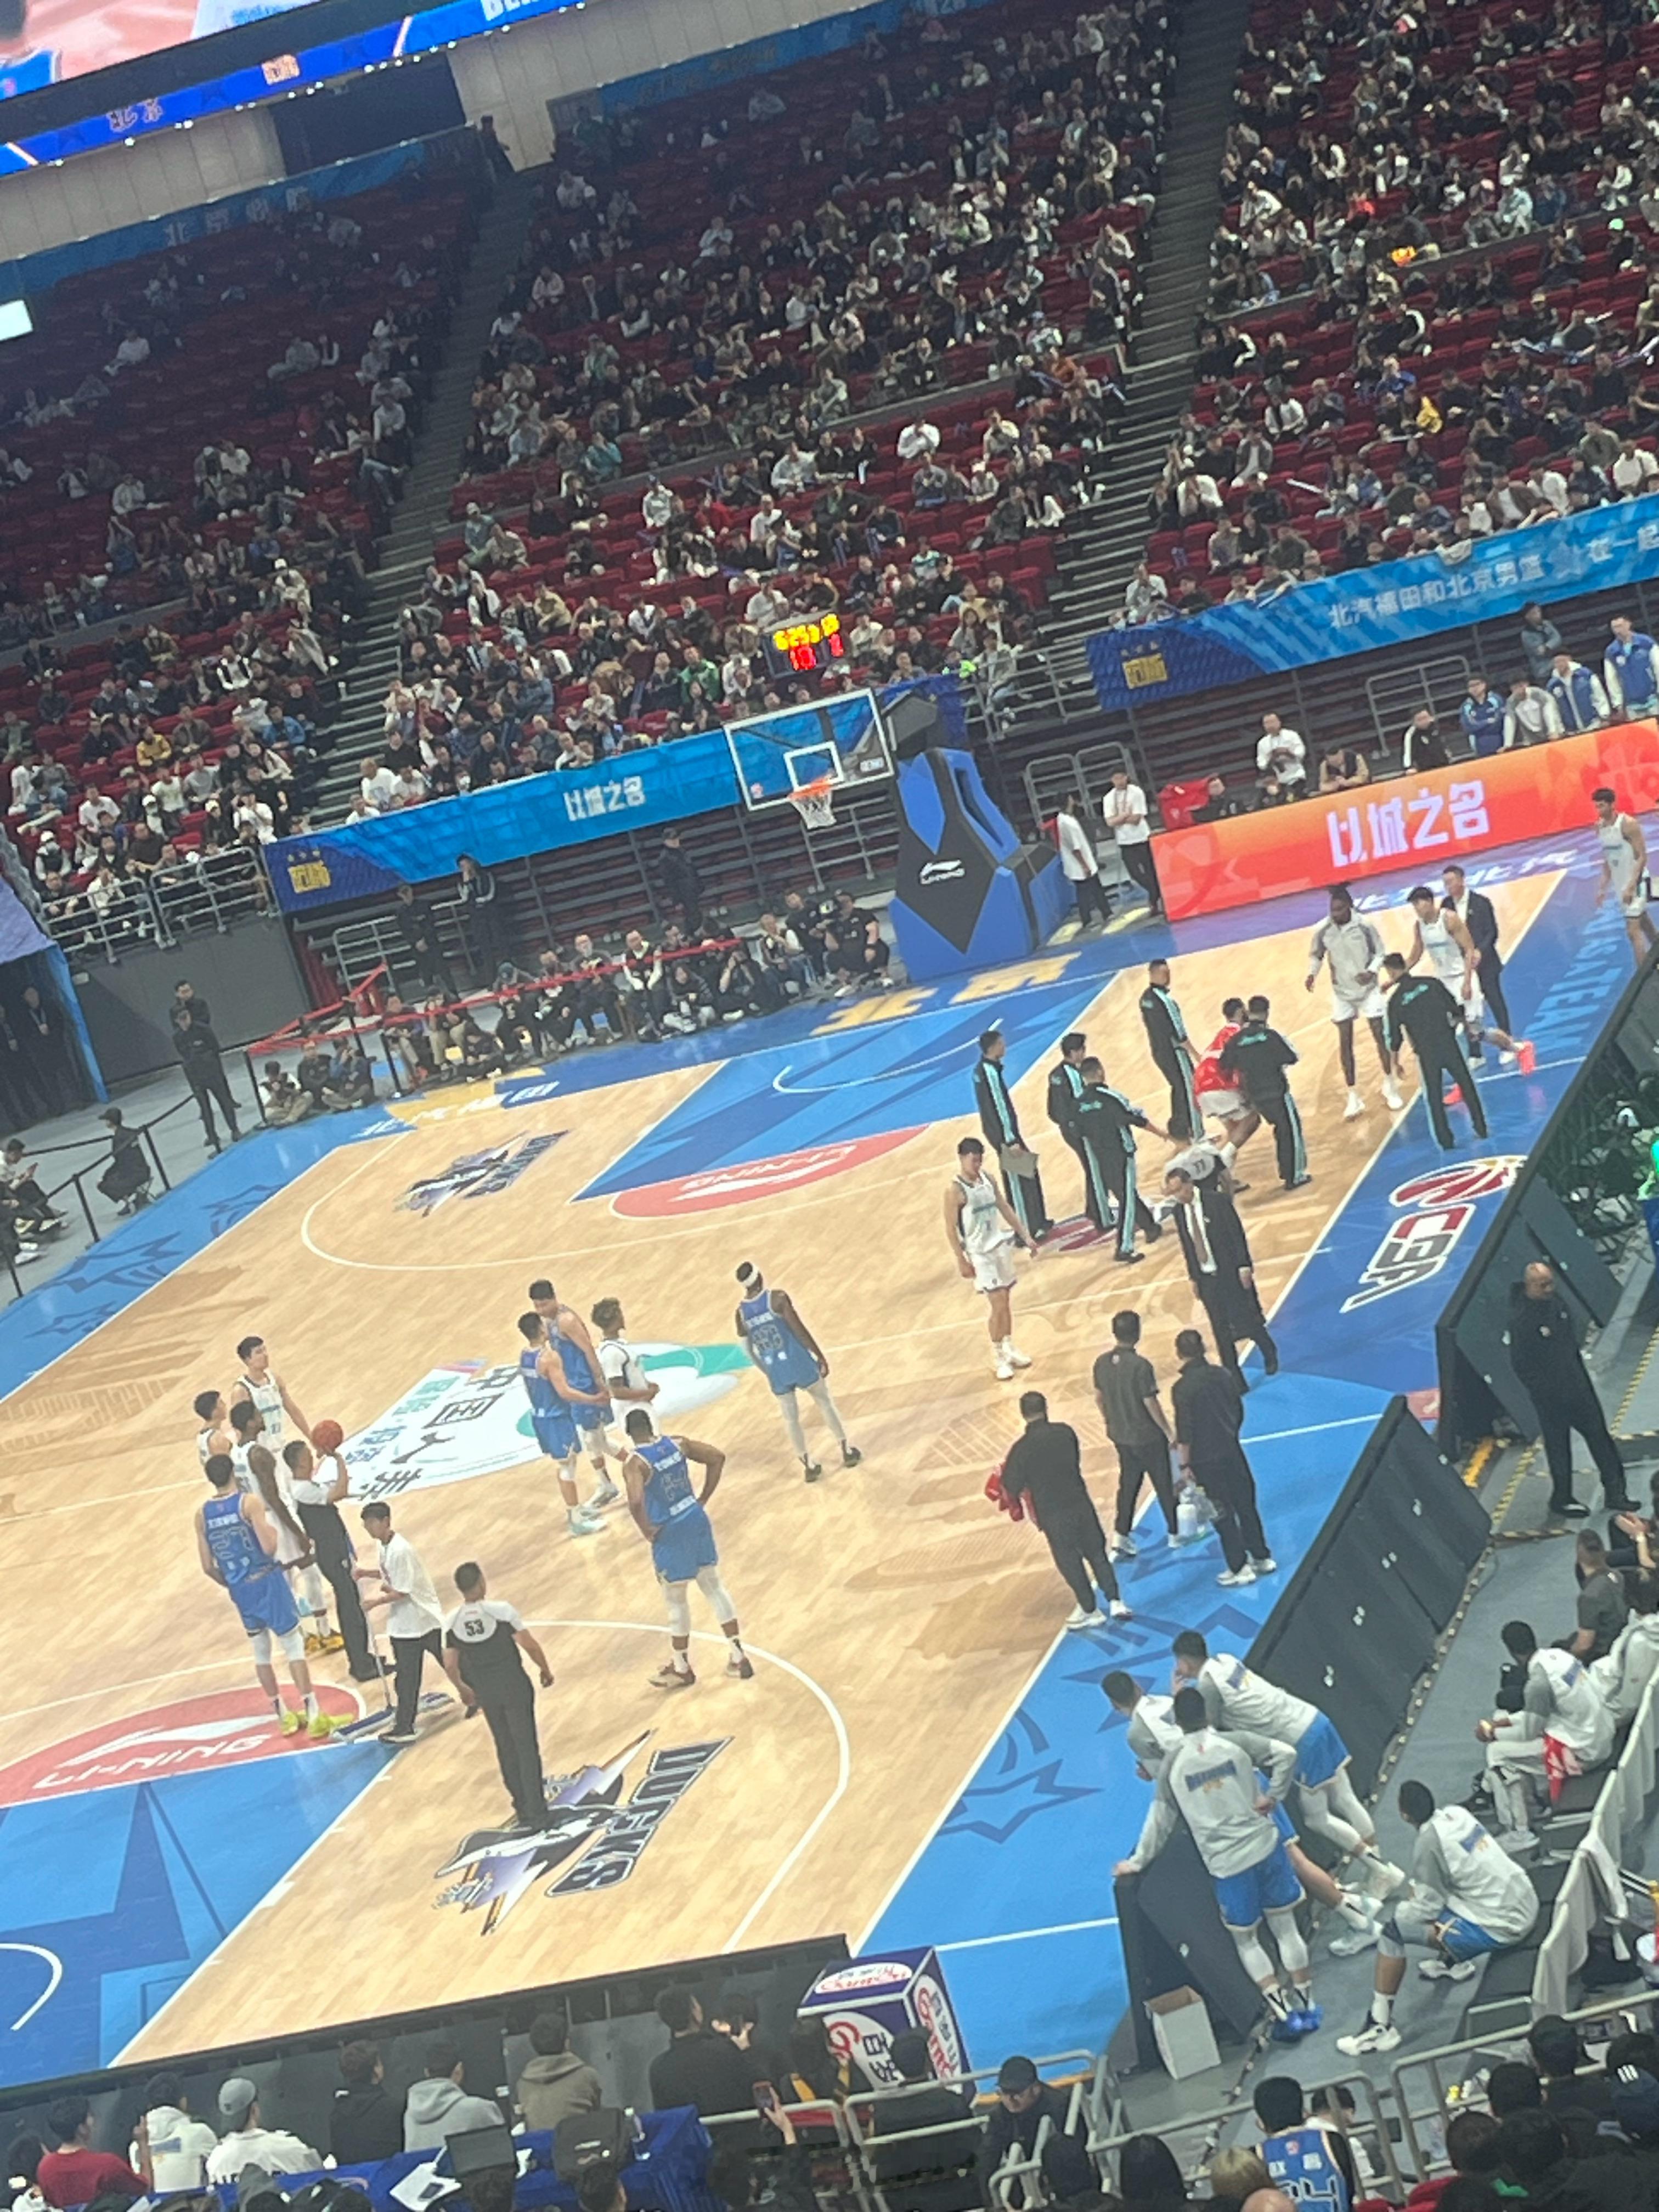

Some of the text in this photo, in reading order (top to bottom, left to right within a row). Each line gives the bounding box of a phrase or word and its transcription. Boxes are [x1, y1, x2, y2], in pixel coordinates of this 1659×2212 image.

[1328, 554, 1545, 629] 北汽福田和北京男篮
[1327, 780, 1489, 868] 以城之名
[1338, 1203, 1476, 1313] CBA
[348, 1365, 521, 1500] 中国人寿
[464, 1618, 484, 1637] 53
[32, 1734, 273, 1789] LI-NING
